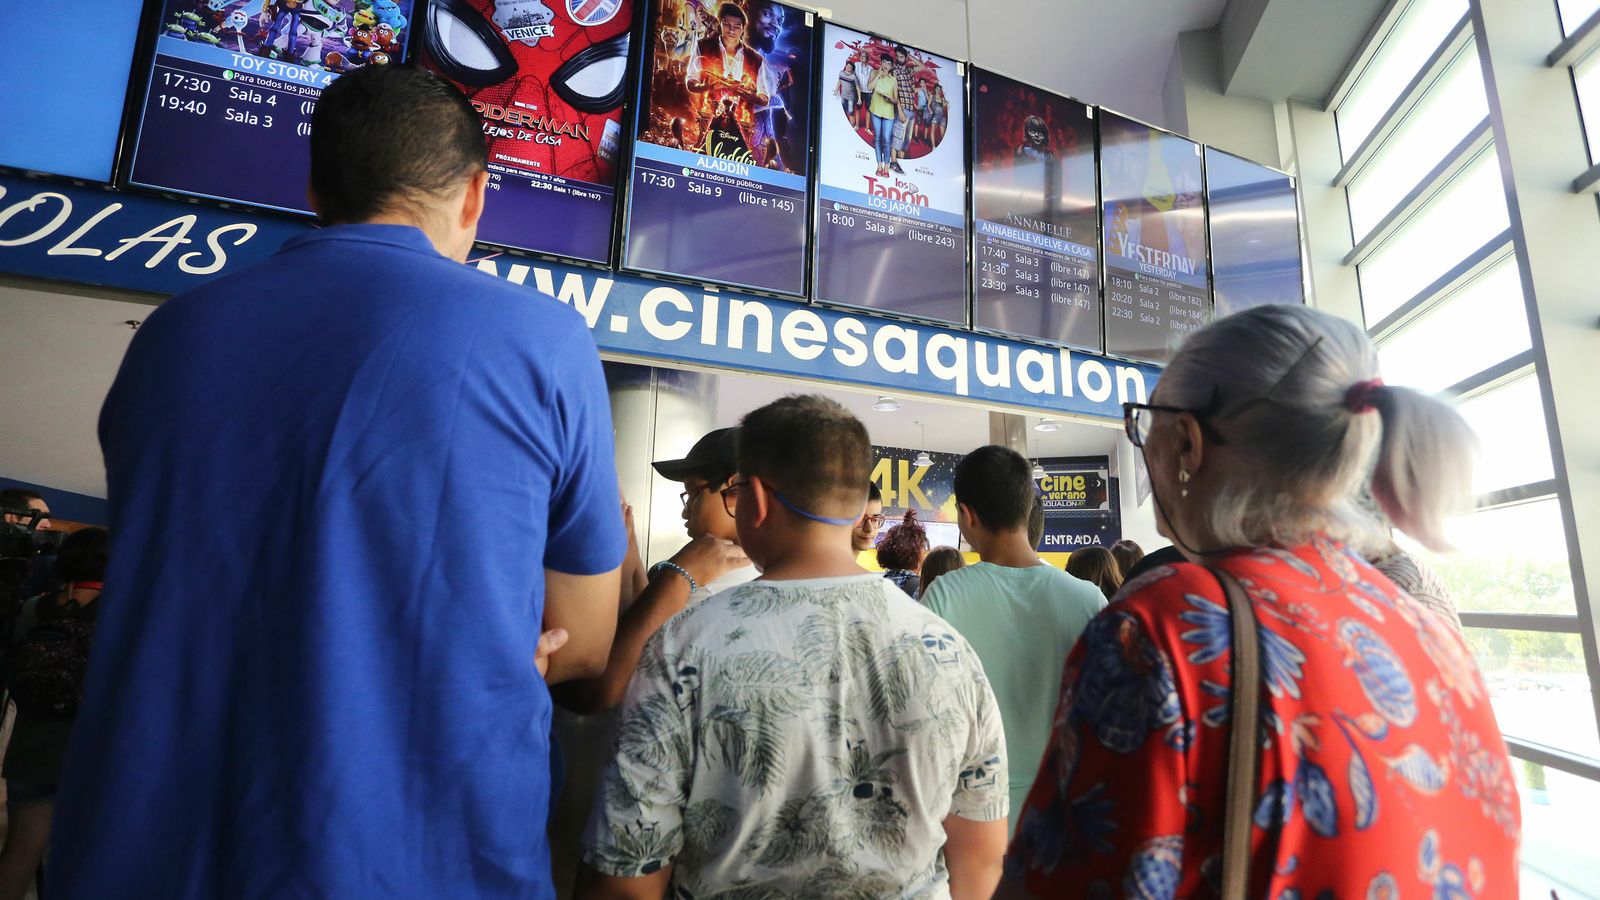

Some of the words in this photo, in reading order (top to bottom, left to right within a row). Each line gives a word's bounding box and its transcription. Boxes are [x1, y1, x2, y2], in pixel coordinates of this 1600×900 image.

[506, 26, 548, 39] VENICE
[231, 53, 265, 71] TOY
[267, 61, 319, 83] STORY
[321, 74, 332, 87] 4
[163, 72, 211, 93] 17:30
[229, 86, 262, 104] Sala
[266, 94, 277, 107] 4
[300, 101, 315, 116] (li
[234, 72, 254, 83] Para
[257, 77, 282, 90] todos
[284, 82, 297, 93] los
[299, 86, 321, 98] públi
[159, 94, 207, 115] 19:40
[225, 108, 258, 126] Sala
[262, 115, 273, 128] 3
[297, 122, 312, 136] (li
[467, 100, 590, 141] PIDER-MAN
[516, 130, 532, 142] DE
[535, 132, 562, 147] CASA
[495, 153, 541, 167] PRÓXIMAMENTE
[697, 156, 749, 176] ALADDÍN
[519, 169, 541, 179] menores
[690, 169, 705, 179] Para
[706, 171, 724, 183] todos
[726, 176, 735, 185] los
[736, 178, 763, 191] públicos
[895, 177, 908, 189] los
[531, 180, 553, 191] 22:30
[553, 185, 566, 194] Sala
[572, 189, 587, 198] (libre
[588, 192, 602, 201] 167)
[641, 172, 675, 189] 17:30
[688, 181, 712, 196] Sala
[715, 187, 722, 198] 9
[738, 191, 768, 207] (libre
[771, 198, 794, 213] 145)
[849, 206, 888, 219] recomendada
[889, 214, 901, 223] para
[902, 216, 926, 228] menores
[927, 221, 934, 229] de
[939, 224, 952, 233] años
[868, 197, 887, 210] LOS
[888, 201, 920, 217] JAPÓN
[0, 186, 257, 275] OLAS
[826, 213, 855, 228] 18:00
[865, 221, 885, 233] Sala
[888, 226, 894, 235] 8
[908, 230, 933, 243] (libre
[935, 235, 955, 249] 243)
[1004, 211, 1073, 239] ANNABELLE
[982, 223, 1031, 242] ANNABELLE
[1032, 235, 1062, 250] VUELVE
[1064, 243, 1070, 252] A
[1071, 245, 1092, 257] CASA
[1000, 240, 1032, 252] recomendada
[982, 245, 1006, 259] 17:40
[1015, 253, 1032, 265] Sala
[1034, 258, 1039, 267] 3
[1050, 262, 1071, 275] (libre
[1073, 267, 1090, 280] 147)
[1139, 262, 1177, 279] YESTERDAY
[981, 261, 1007, 276] 21:30
[1015, 269, 1032, 281] Sala
[1034, 273, 1039, 283] 3
[1050, 277, 1072, 288] (libre
[1073, 282, 1090, 295] 147)
[1112, 277, 1132, 290] 18:10
[1139, 283, 1153, 294] Sala
[1155, 287, 1160, 296] 2
[1169, 291, 1186, 303] (libre
[982, 277, 1007, 292] 23:30
[1015, 285, 1032, 297] Sala
[1034, 289, 1040, 298] 3
[1051, 293, 1072, 304] (libre
[1073, 298, 1091, 311] 147)
[1112, 292, 1132, 304] 20:20
[1139, 298, 1154, 309] Sala
[1155, 302, 1160, 310] 2
[1169, 305, 1187, 317] (libre
[1112, 306, 1133, 320] 22:30
[1140, 313, 1154, 325] Sala
[1156, 317, 1160, 325] 2
[869, 457, 934, 511] 4K
[1041, 475, 1086, 492] cine
[1049, 491, 1087, 500] verano
[1045, 534, 1102, 545] ENTRADA
